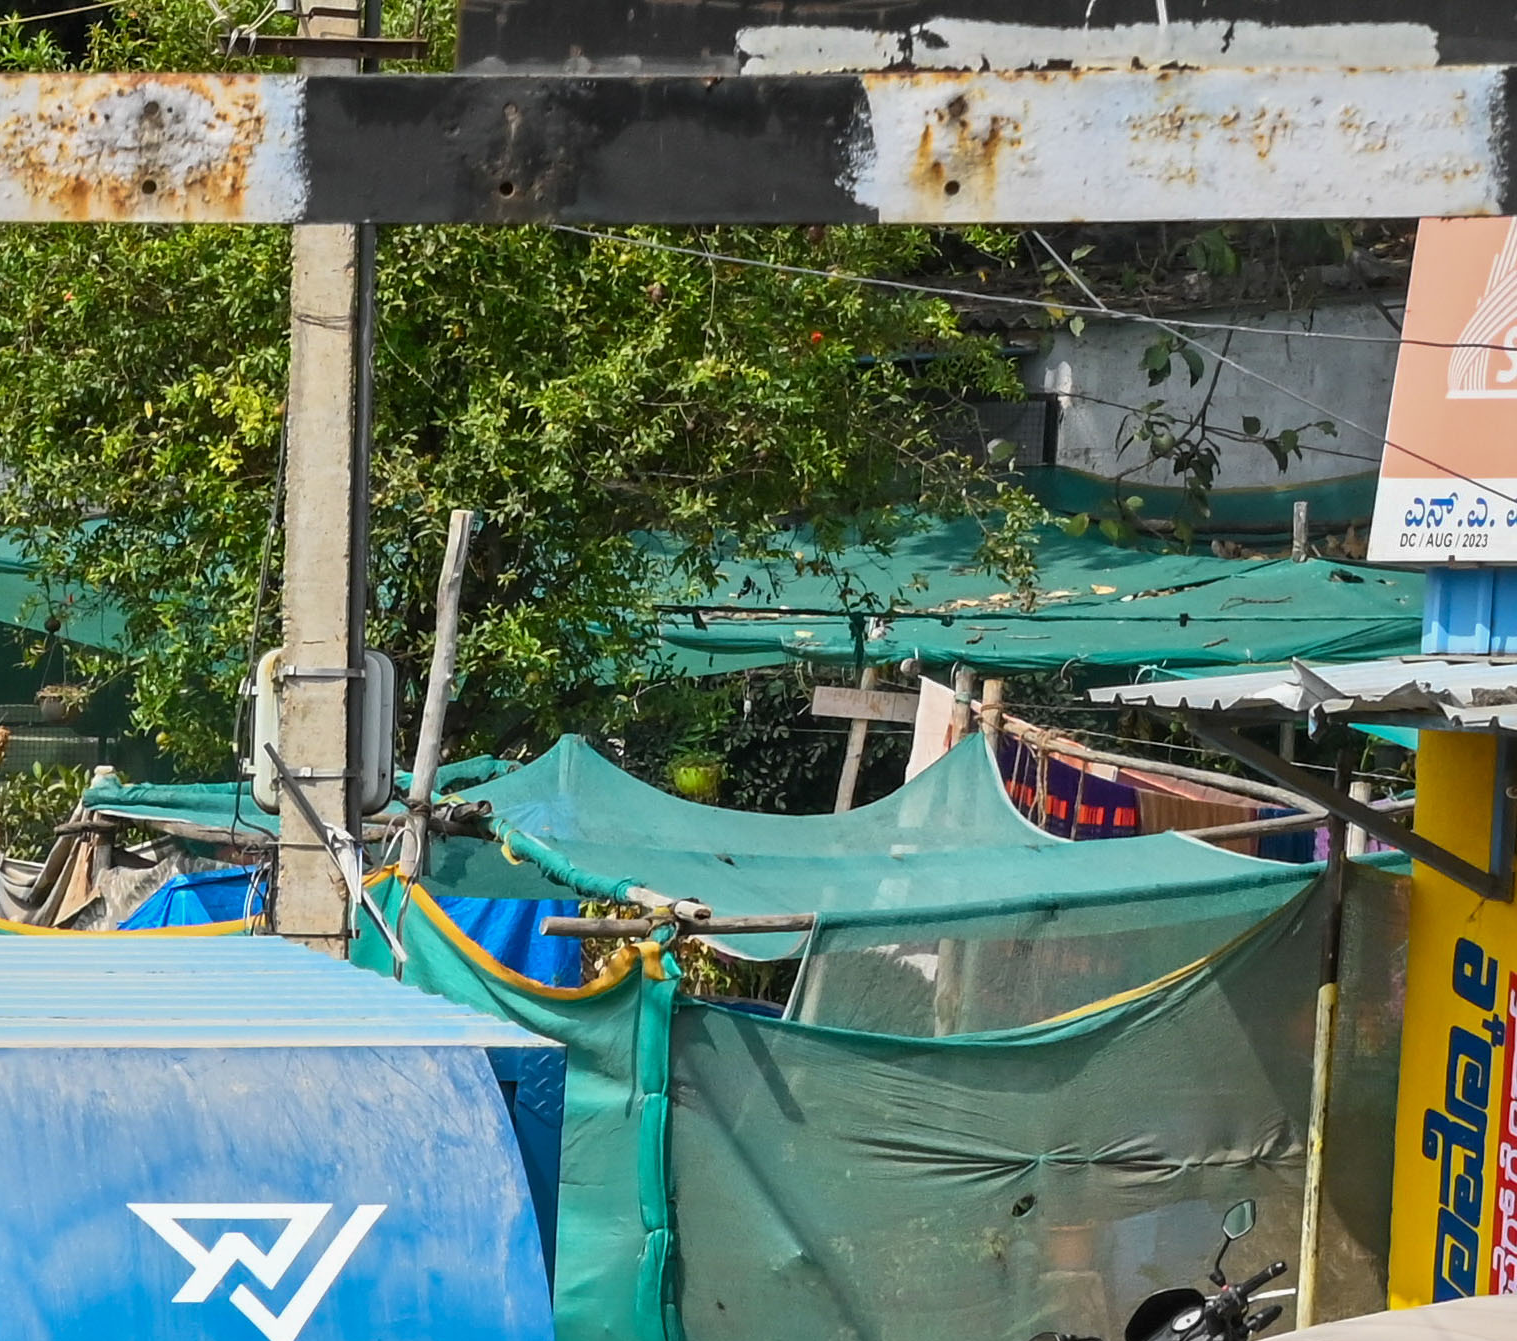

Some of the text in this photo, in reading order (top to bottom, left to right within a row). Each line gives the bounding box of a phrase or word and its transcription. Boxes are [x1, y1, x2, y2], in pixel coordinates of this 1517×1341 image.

[1400, 532, 1418, 548] DC
[1426, 532, 1454, 548] AUG
[1462, 532, 1489, 548] 2023
